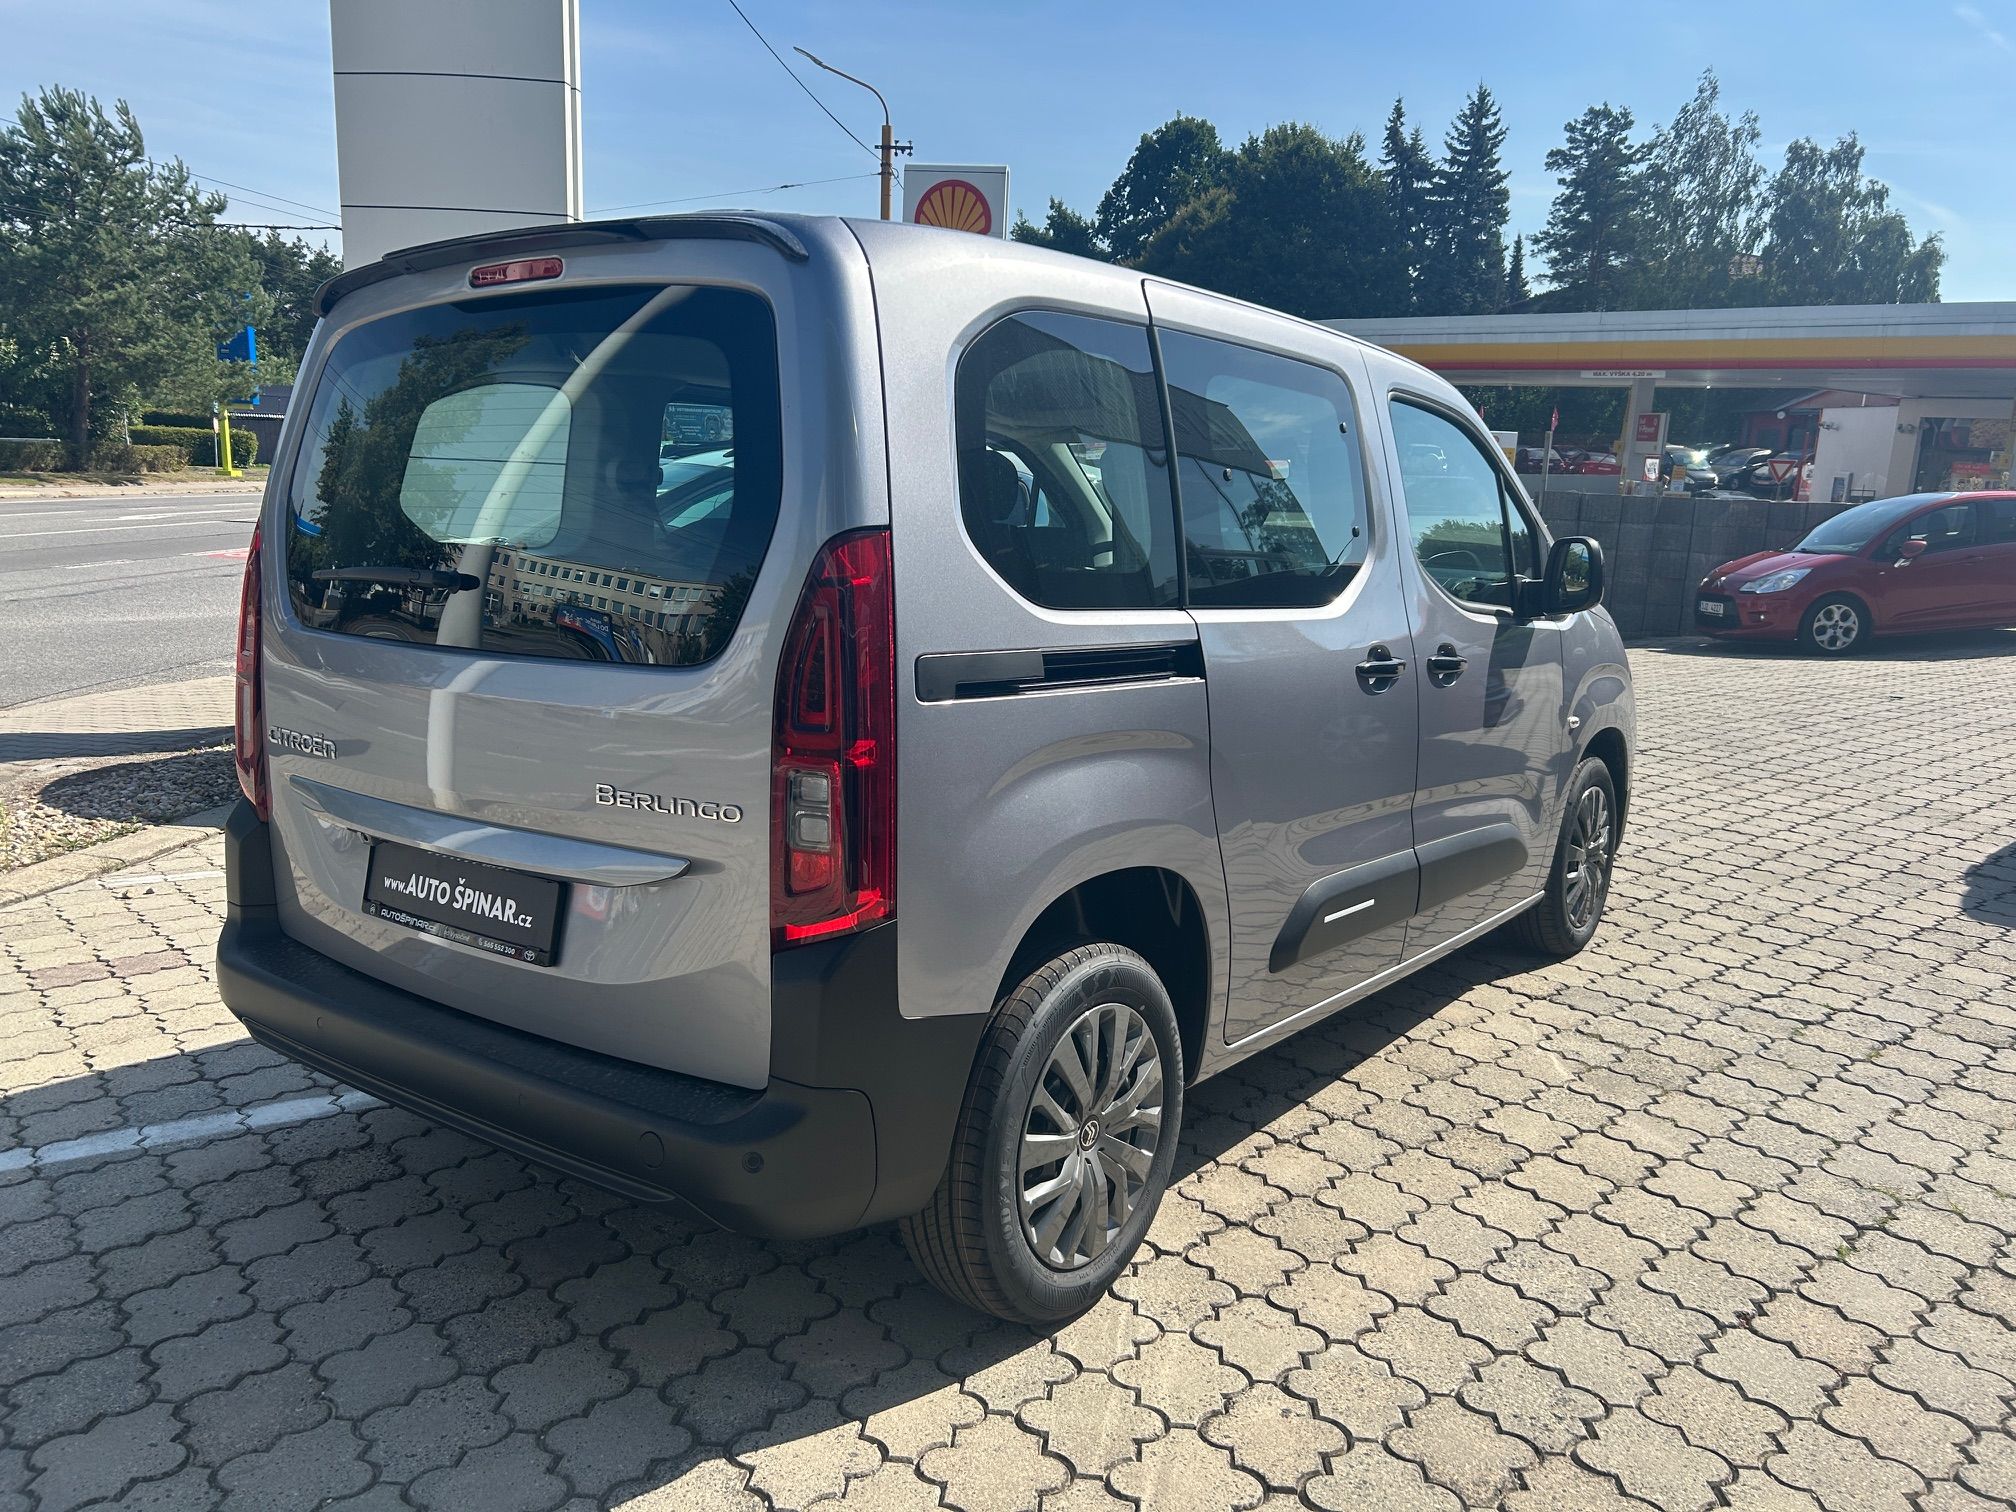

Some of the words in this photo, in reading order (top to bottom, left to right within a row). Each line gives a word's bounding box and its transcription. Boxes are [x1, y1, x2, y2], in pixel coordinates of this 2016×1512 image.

[269, 725, 337, 760] CITROËN
[595, 783, 744, 823] BERLINGO
[384, 873, 450, 905] www.AUTO
[452, 877, 533, 928] ŠPINAR.cz
[504, 946, 515, 955] 300
